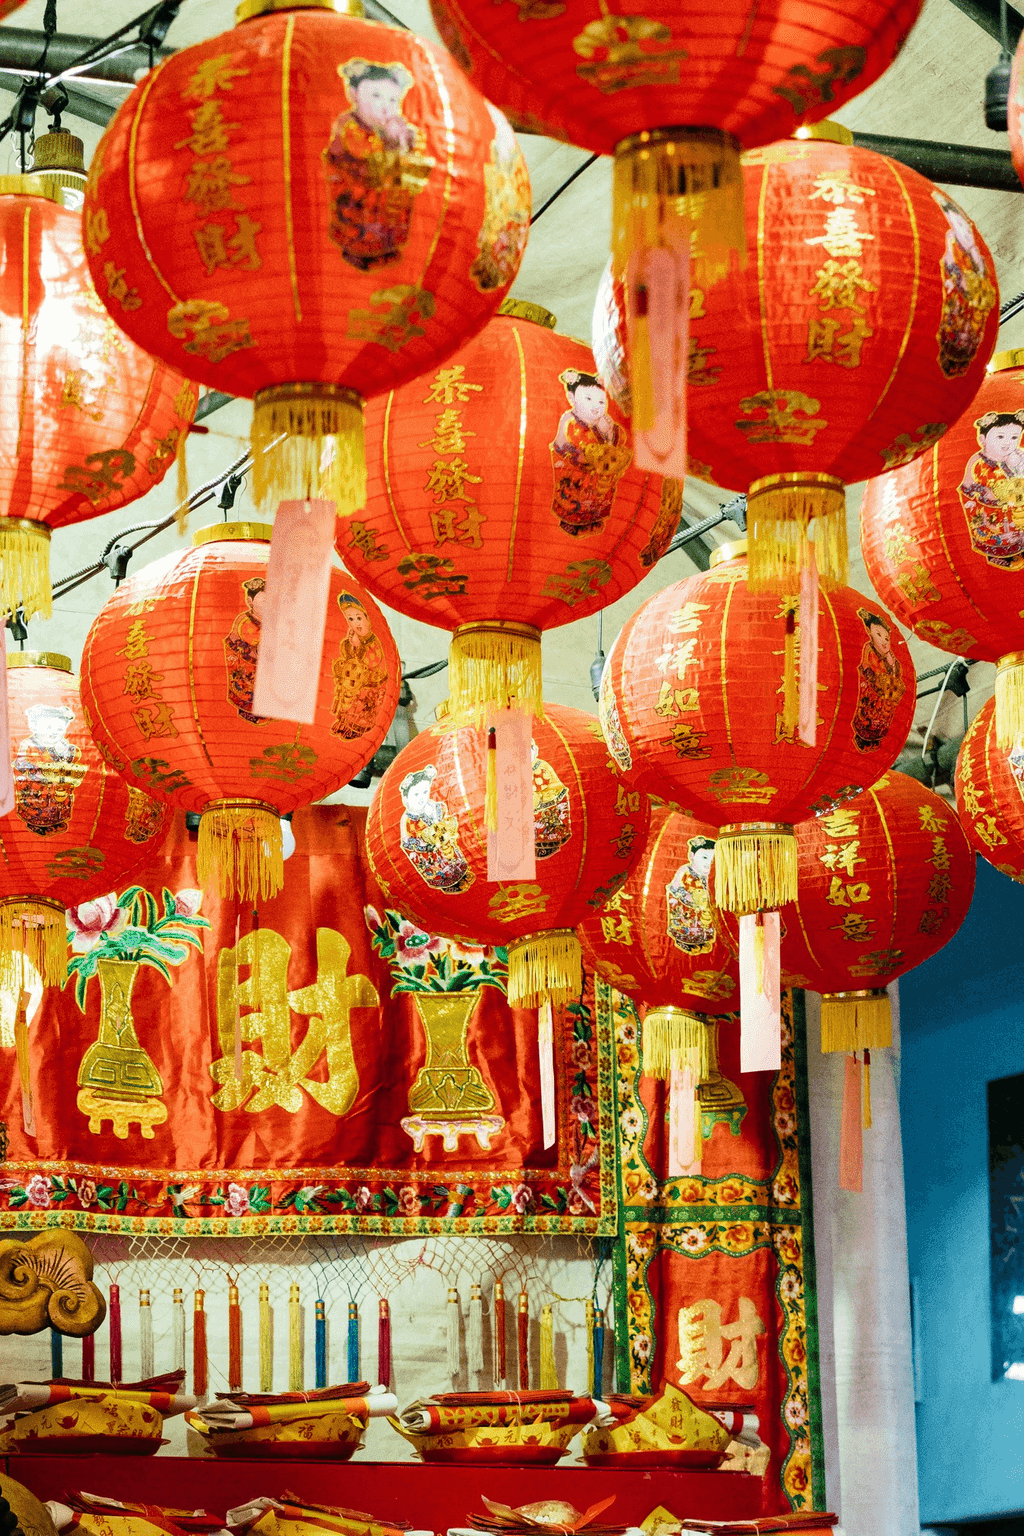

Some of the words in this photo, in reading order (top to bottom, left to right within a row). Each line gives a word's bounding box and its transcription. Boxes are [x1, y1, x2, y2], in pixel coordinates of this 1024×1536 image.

[173, 52, 263, 276] 恭喜發財
[801, 170, 878, 370] 恭喜發財
[418, 365, 488, 550] 恭喜發財
[654, 602, 713, 761] 吉祥如意
[818, 808, 876, 942] 吉祥如意
[210, 926, 380, 1115] 財
[678, 1297, 767, 1390] 財
